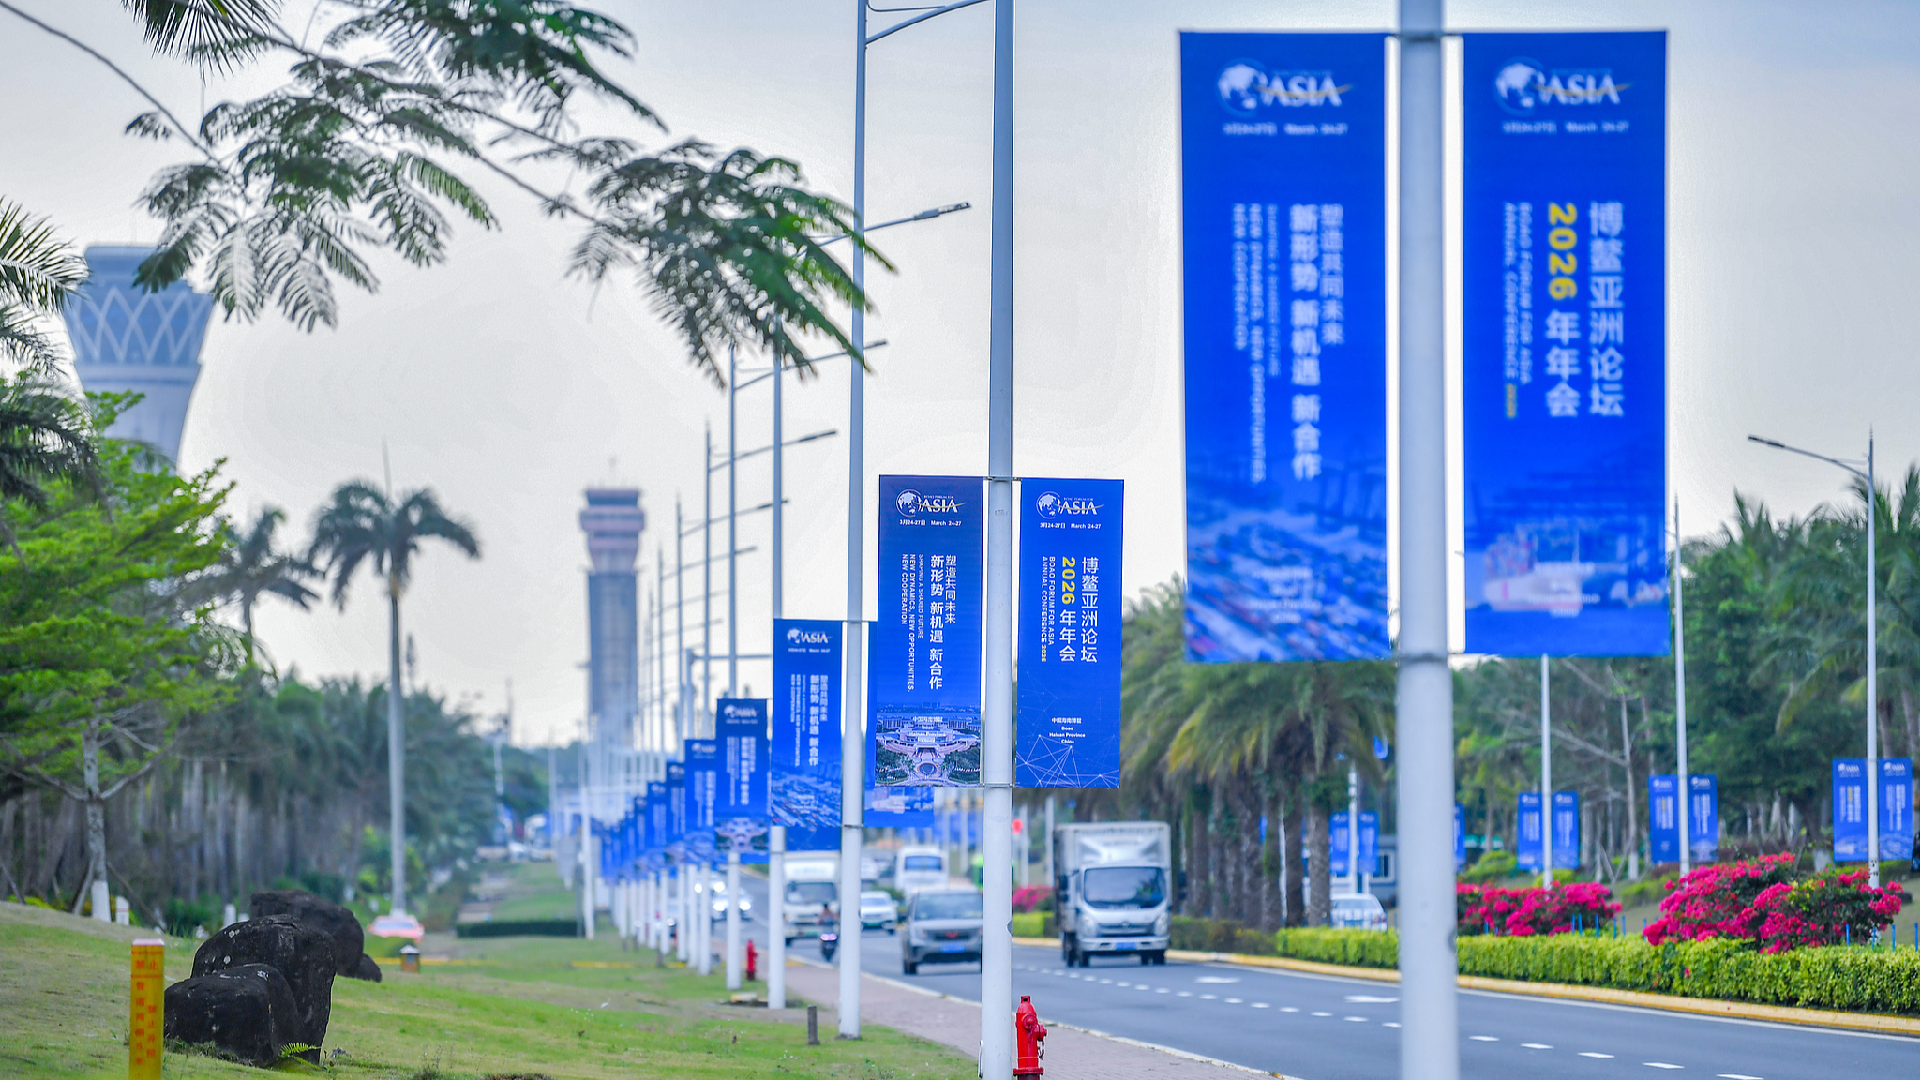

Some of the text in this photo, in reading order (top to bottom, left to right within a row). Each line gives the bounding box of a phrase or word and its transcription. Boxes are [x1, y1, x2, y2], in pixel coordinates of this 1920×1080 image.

[1261, 75, 1343, 107] ASIA
[1538, 74, 1621, 105] ASIA
[1546, 202, 1580, 417] 2026 年年会
[921, 499, 958, 513] ASIA
[1060, 501, 1098, 515] ASIA
[1048, 556, 1056, 579] BOAO
[901, 553, 909, 625] NEW COOPERATION
[945, 554, 957, 624] 塑造共同未来
[1048, 580, 1056, 608] FORUM
[908, 613, 916, 631] NEW
[929, 554, 944, 690] 新形势 新机遇 新合作
[1059, 556, 1077, 662] 2026 年年会
[1081, 556, 1099, 663] 博鳌亚洲论坛
[801, 631, 829, 644] ASIA
